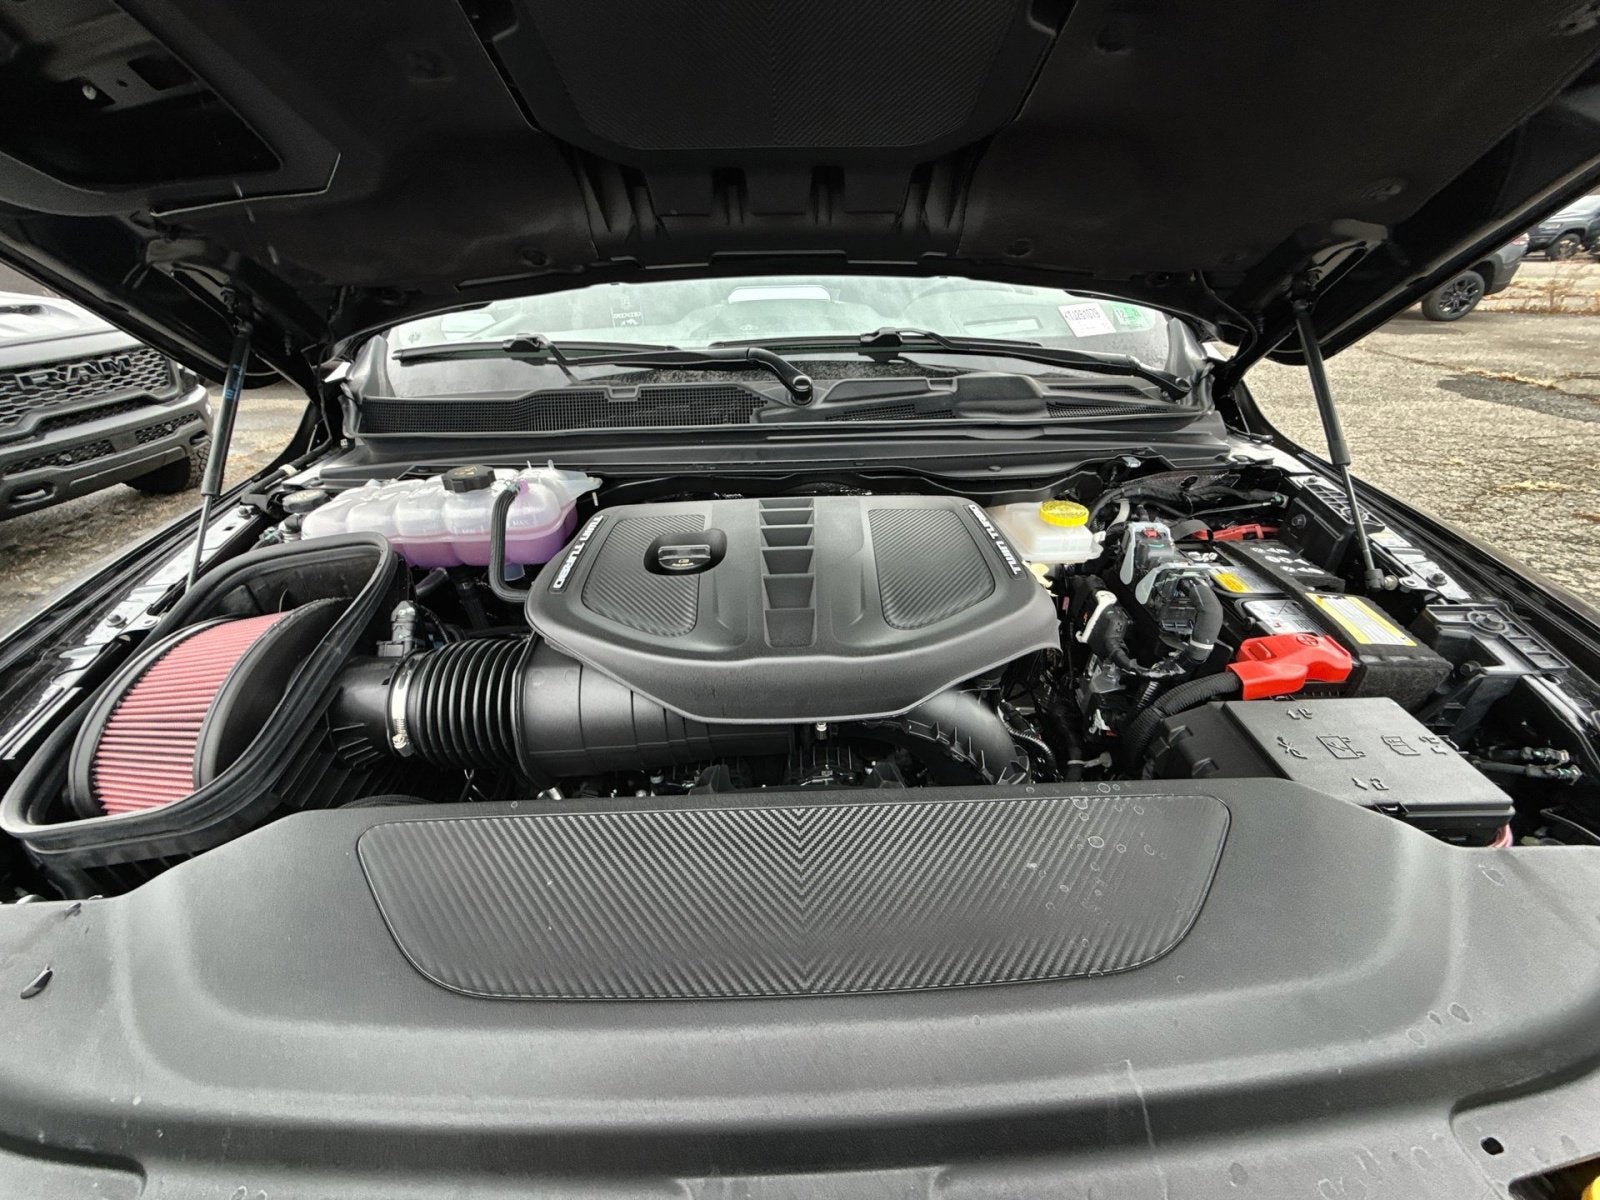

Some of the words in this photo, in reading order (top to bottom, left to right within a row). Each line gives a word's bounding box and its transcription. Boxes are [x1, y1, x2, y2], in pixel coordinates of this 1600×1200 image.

[14, 355, 132, 390] RAM
[579, 515, 604, 541] TWIN
[968, 504, 999, 540] TURBO
[553, 542, 585, 588] TURBO
[995, 541, 1022, 575] TWIN
